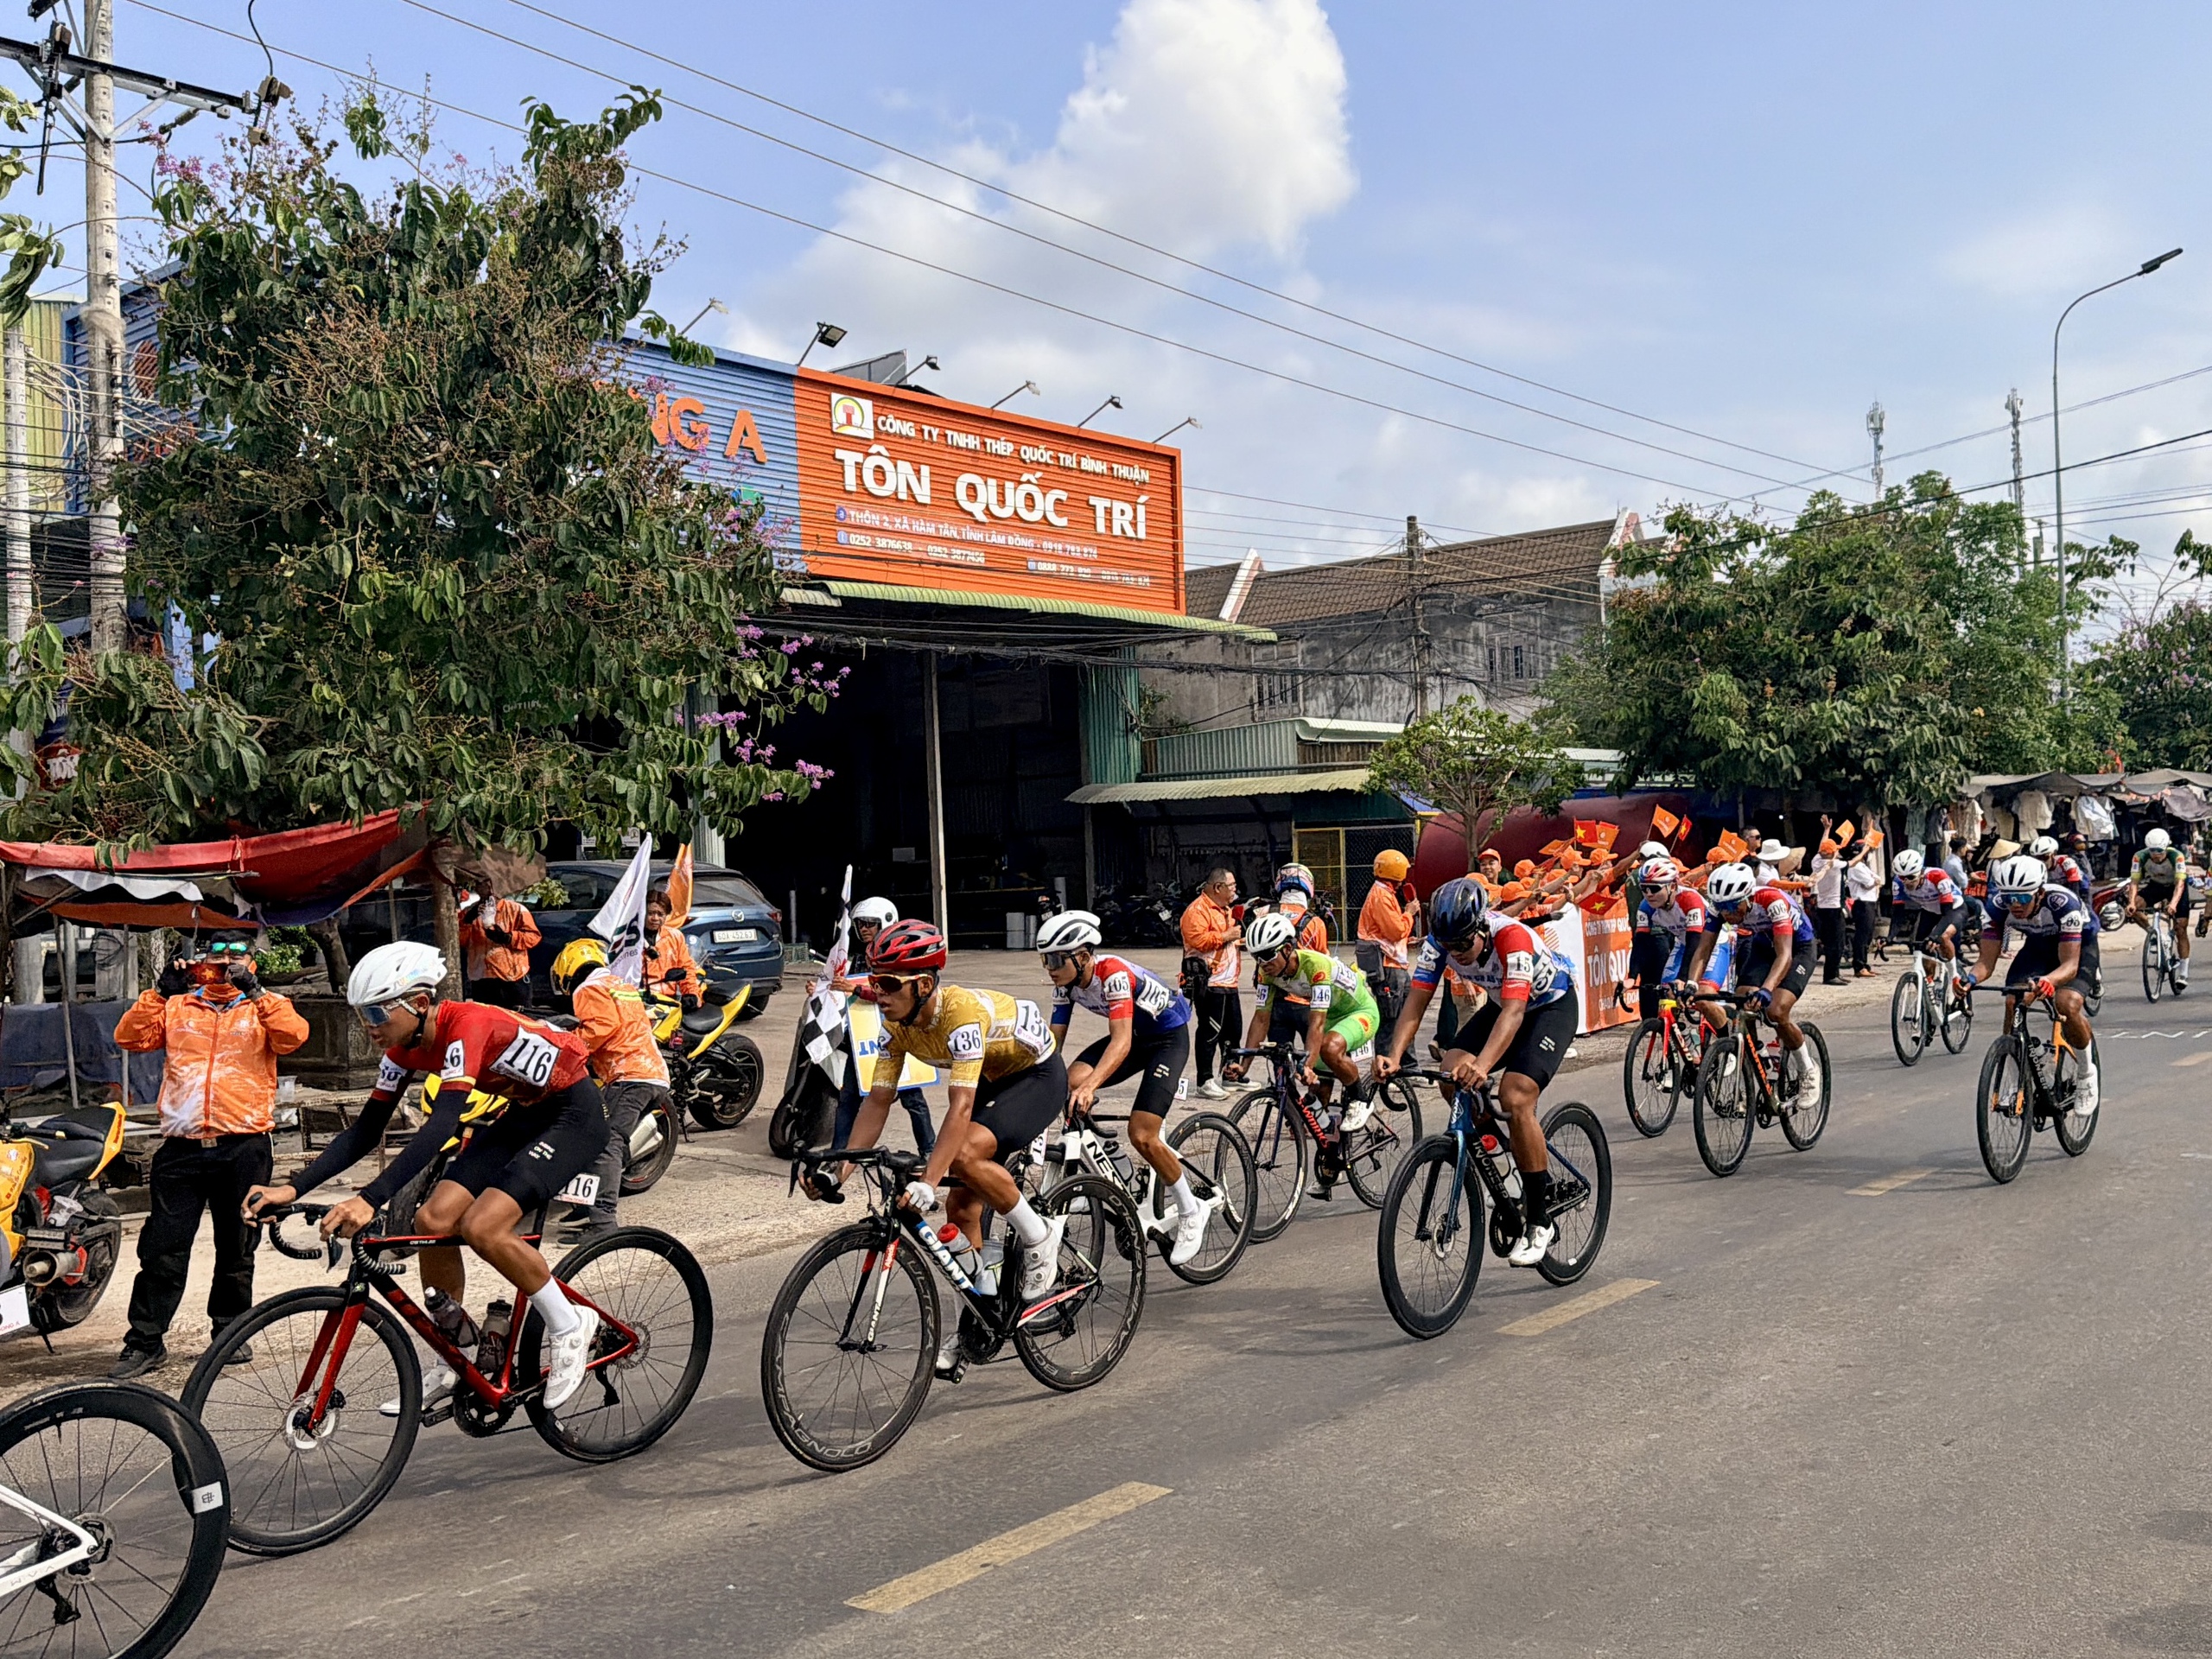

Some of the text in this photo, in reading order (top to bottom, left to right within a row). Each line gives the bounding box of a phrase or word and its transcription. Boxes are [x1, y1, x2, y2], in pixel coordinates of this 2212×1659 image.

[724, 409, 767, 462] A
[877, 414, 1150, 486] CÔNG TY TNHH THÉP QUỐC TRÍ BÌNH THUẬN
[834, 443, 1150, 540] TÔN QUỐC TRÍ
[849, 510, 880, 525] THÔN
[894, 516, 910, 531] XÃ
[912, 518, 936, 535] HÀM
[938, 523, 960, 540] TÂN,
[961, 524, 984, 543] TỈNH
[985, 530, 1006, 545] LÂM
[1007, 531, 1035, 549] ĐỒNG
[849, 533, 872, 547] 0252
[1515, 955, 1531, 972] 15
[1587, 944, 1607, 988] TÔN
[1108, 976, 1129, 994] 105
[1313, 987, 1329, 1002] 146
[954, 1029, 981, 1052] 136
[505, 1038, 552, 1083] 116
[868, 1302, 881, 1342] GIANT
